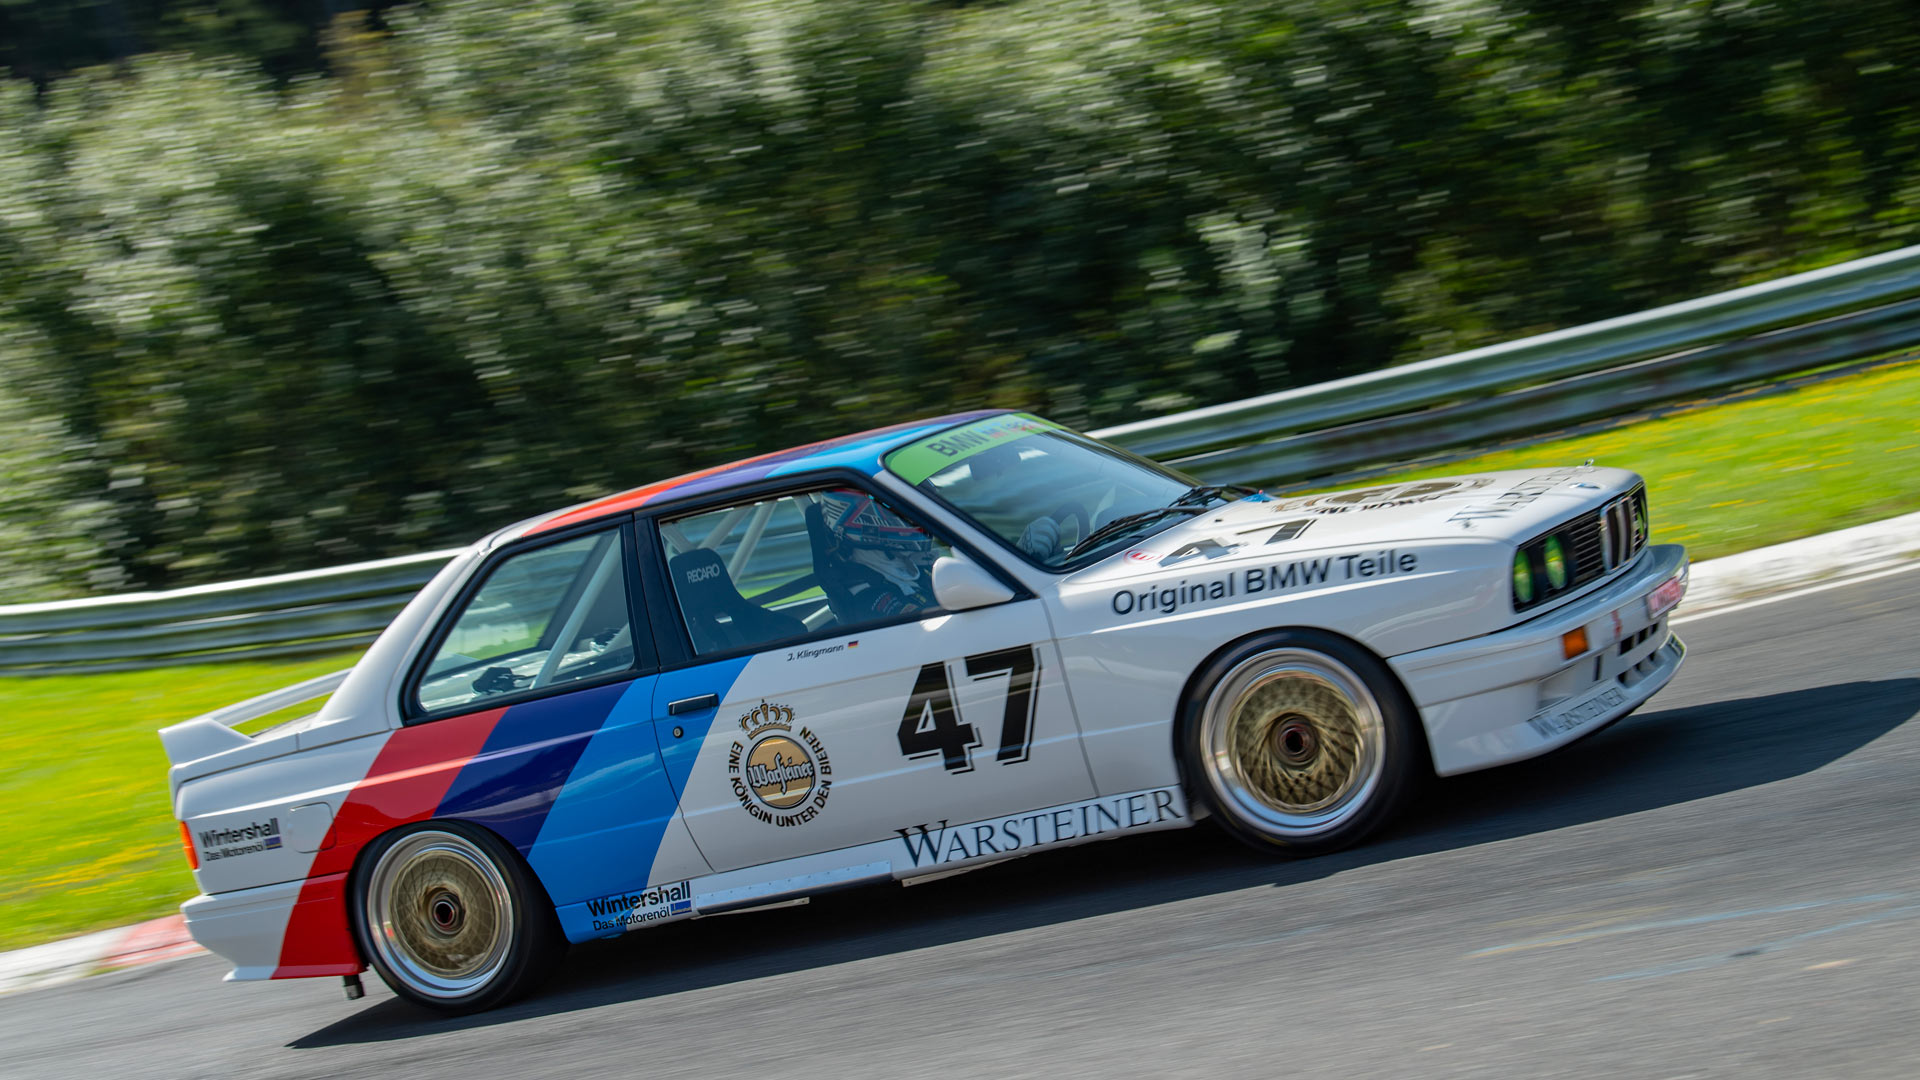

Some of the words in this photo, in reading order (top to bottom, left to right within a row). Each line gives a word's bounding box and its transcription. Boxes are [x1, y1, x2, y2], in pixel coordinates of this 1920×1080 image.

[926, 430, 990, 457] BMW
[1157, 518, 1317, 568] 47
[686, 563, 720, 584] RECARO
[1112, 572, 1234, 615] Original
[1245, 556, 1331, 594] BMW
[1338, 549, 1418, 577] Teile
[787, 652, 796, 661] J.
[796, 644, 844, 658] Klingmann
[897, 643, 1042, 775] 47
[729, 741, 744, 774] EINE
[799, 726, 832, 775] BIEREN
[730, 777, 772, 824] KÖNIGIN
[814, 780, 832, 809] DEN
[776, 805, 819, 827] UNTER
[894, 789, 1185, 868] WARSTEINER
[198, 817, 280, 848] Wintershall
[203, 851, 221, 862] Das
[586, 880, 691, 917] Wintershall
[592, 919, 615, 931] Das
[615, 906, 671, 928] Motorenöl
